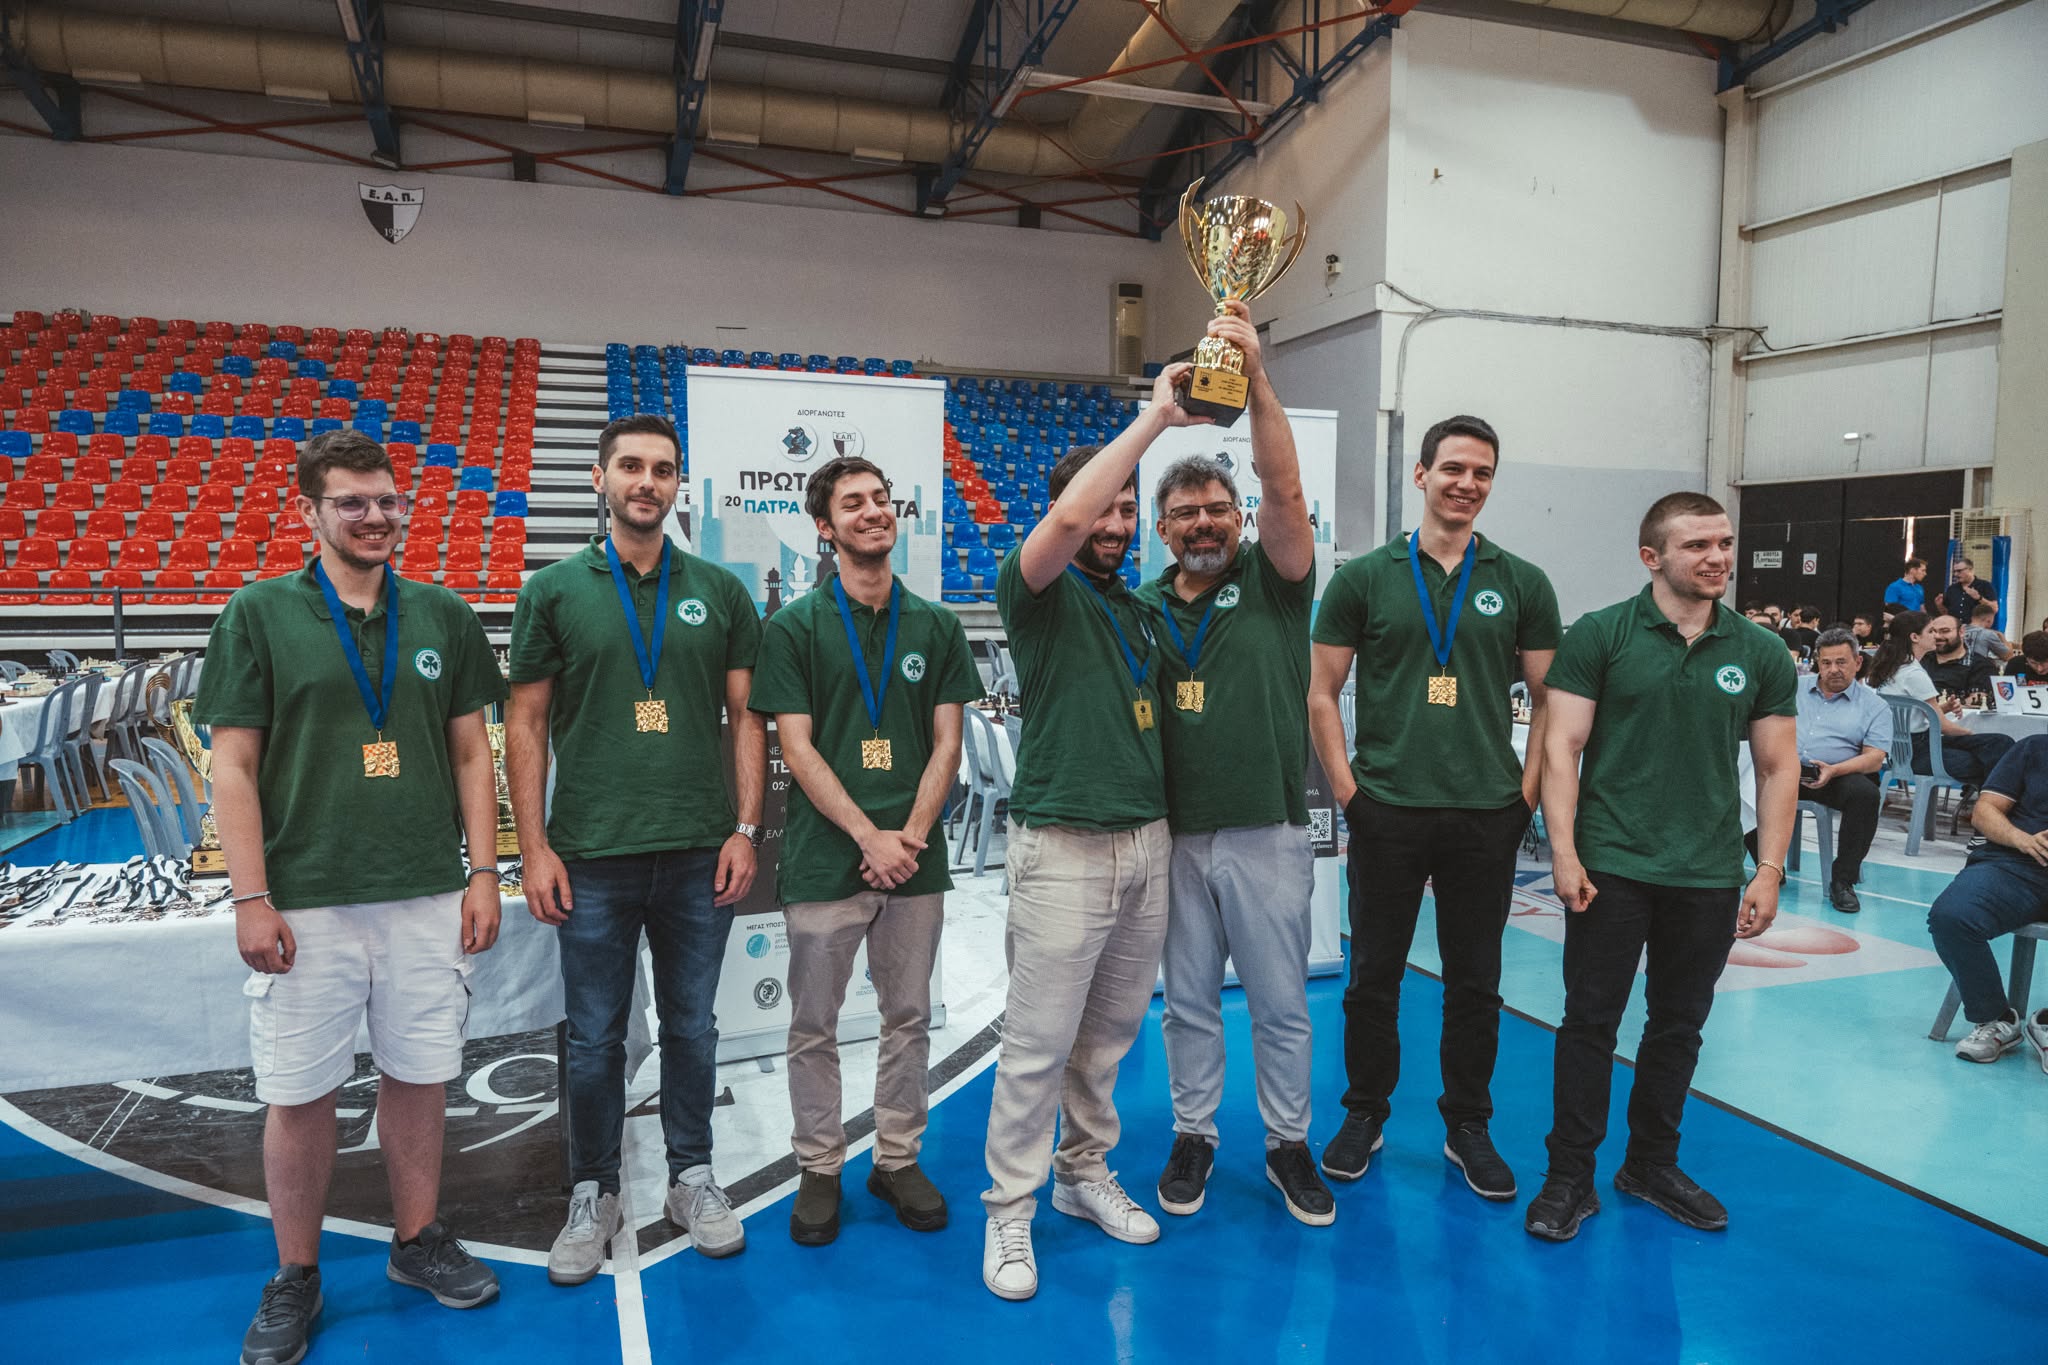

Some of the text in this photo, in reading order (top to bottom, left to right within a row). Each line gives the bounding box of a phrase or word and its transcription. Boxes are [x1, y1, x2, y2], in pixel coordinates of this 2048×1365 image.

[384, 228, 404, 238] 1927
[797, 409, 846, 418] ΔΙΟΡΓΑΝΩΤΕΣ
[740, 470, 808, 491] ΠΡΩΤ
[724, 495, 742, 507] 20
[744, 499, 800, 514] ΠΑΤΡΑ
